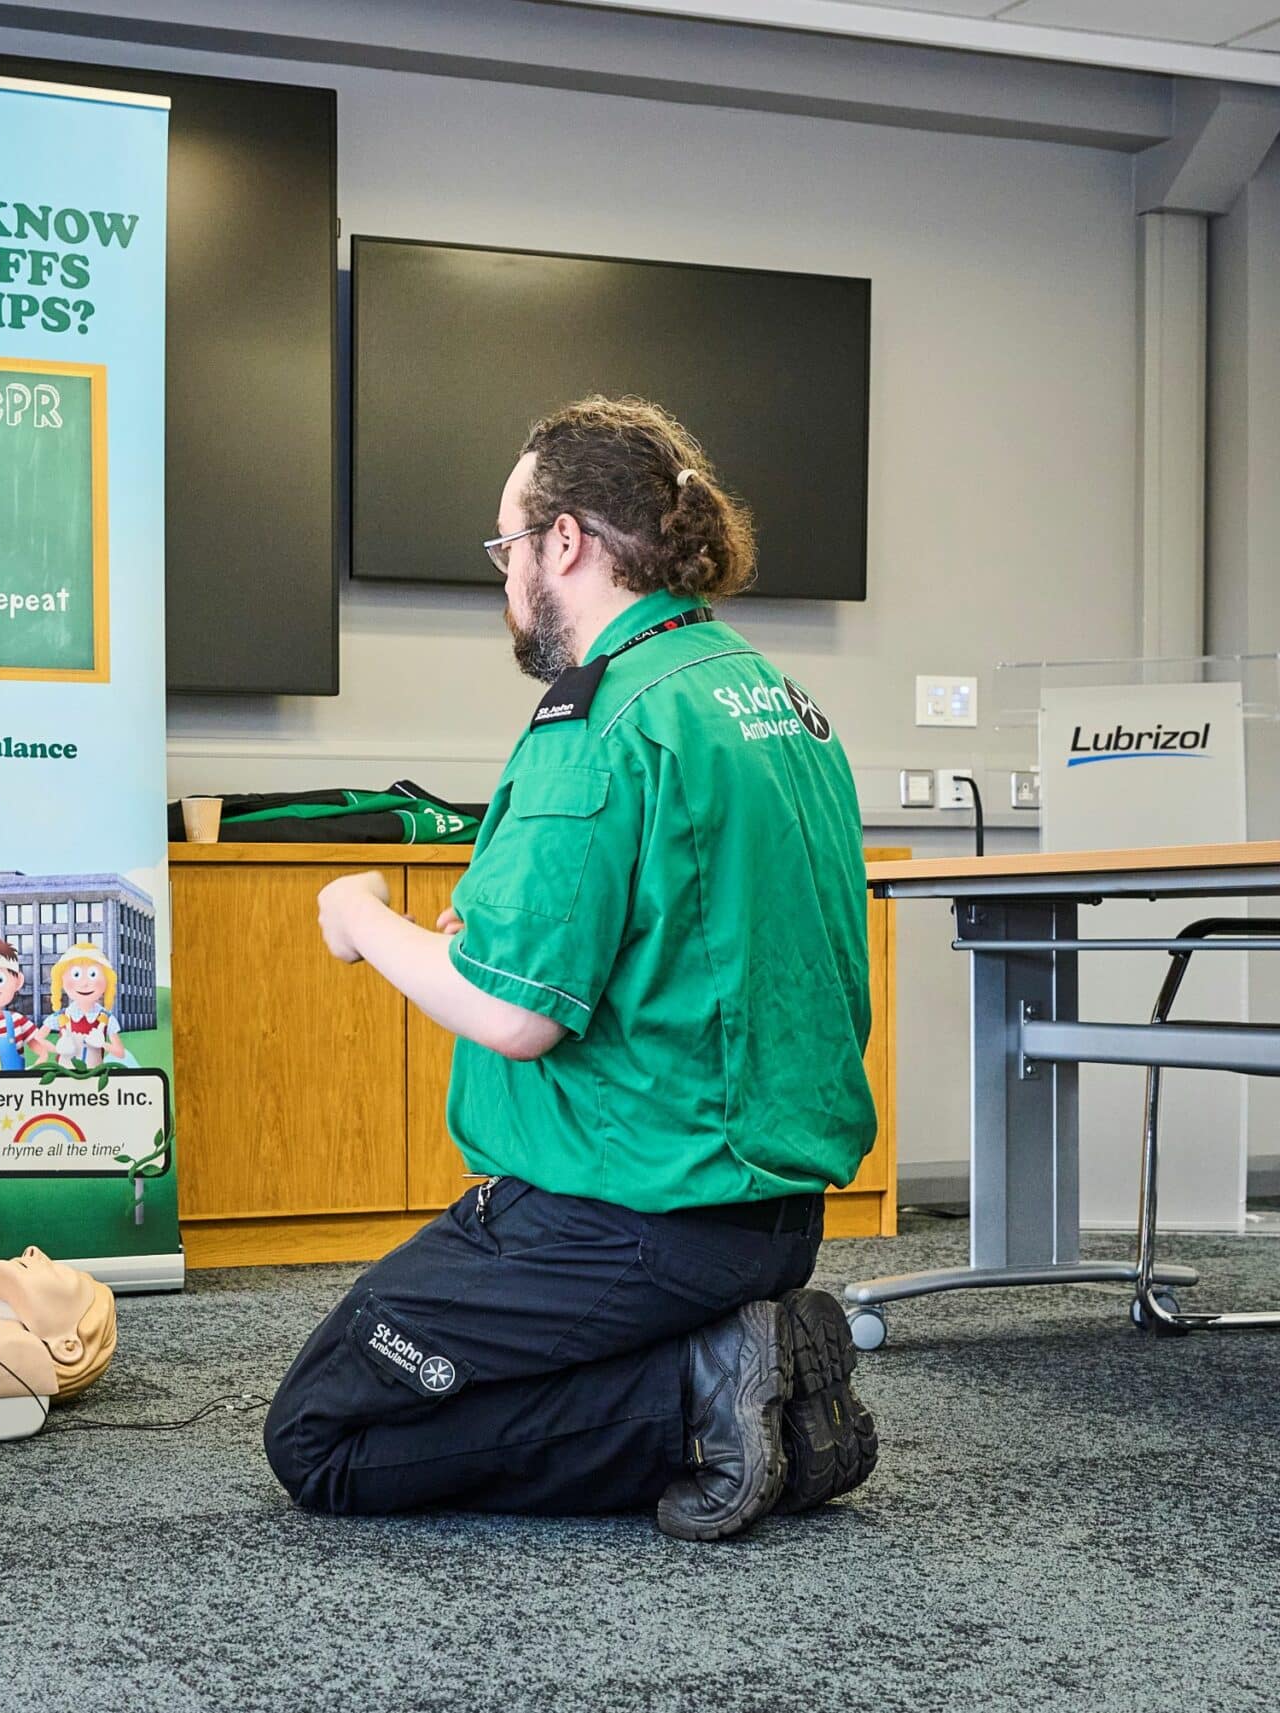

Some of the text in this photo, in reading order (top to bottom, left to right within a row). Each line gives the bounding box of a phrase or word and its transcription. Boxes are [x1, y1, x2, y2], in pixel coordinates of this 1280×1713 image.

[713, 686, 751, 718] St
[1071, 723, 1210, 752] Lubrizol
[31, 1090, 110, 1110] Rhymes
[117, 1088, 153, 1106] Inc.
[2, 1144, 44, 1159] rhyme
[47, 1144, 63, 1157] all
[66, 1143, 88, 1156] the
[92, 1143, 125, 1156] time'
[368, 1337, 417, 1374] Ambulance
[373, 1323, 424, 1364] St John
